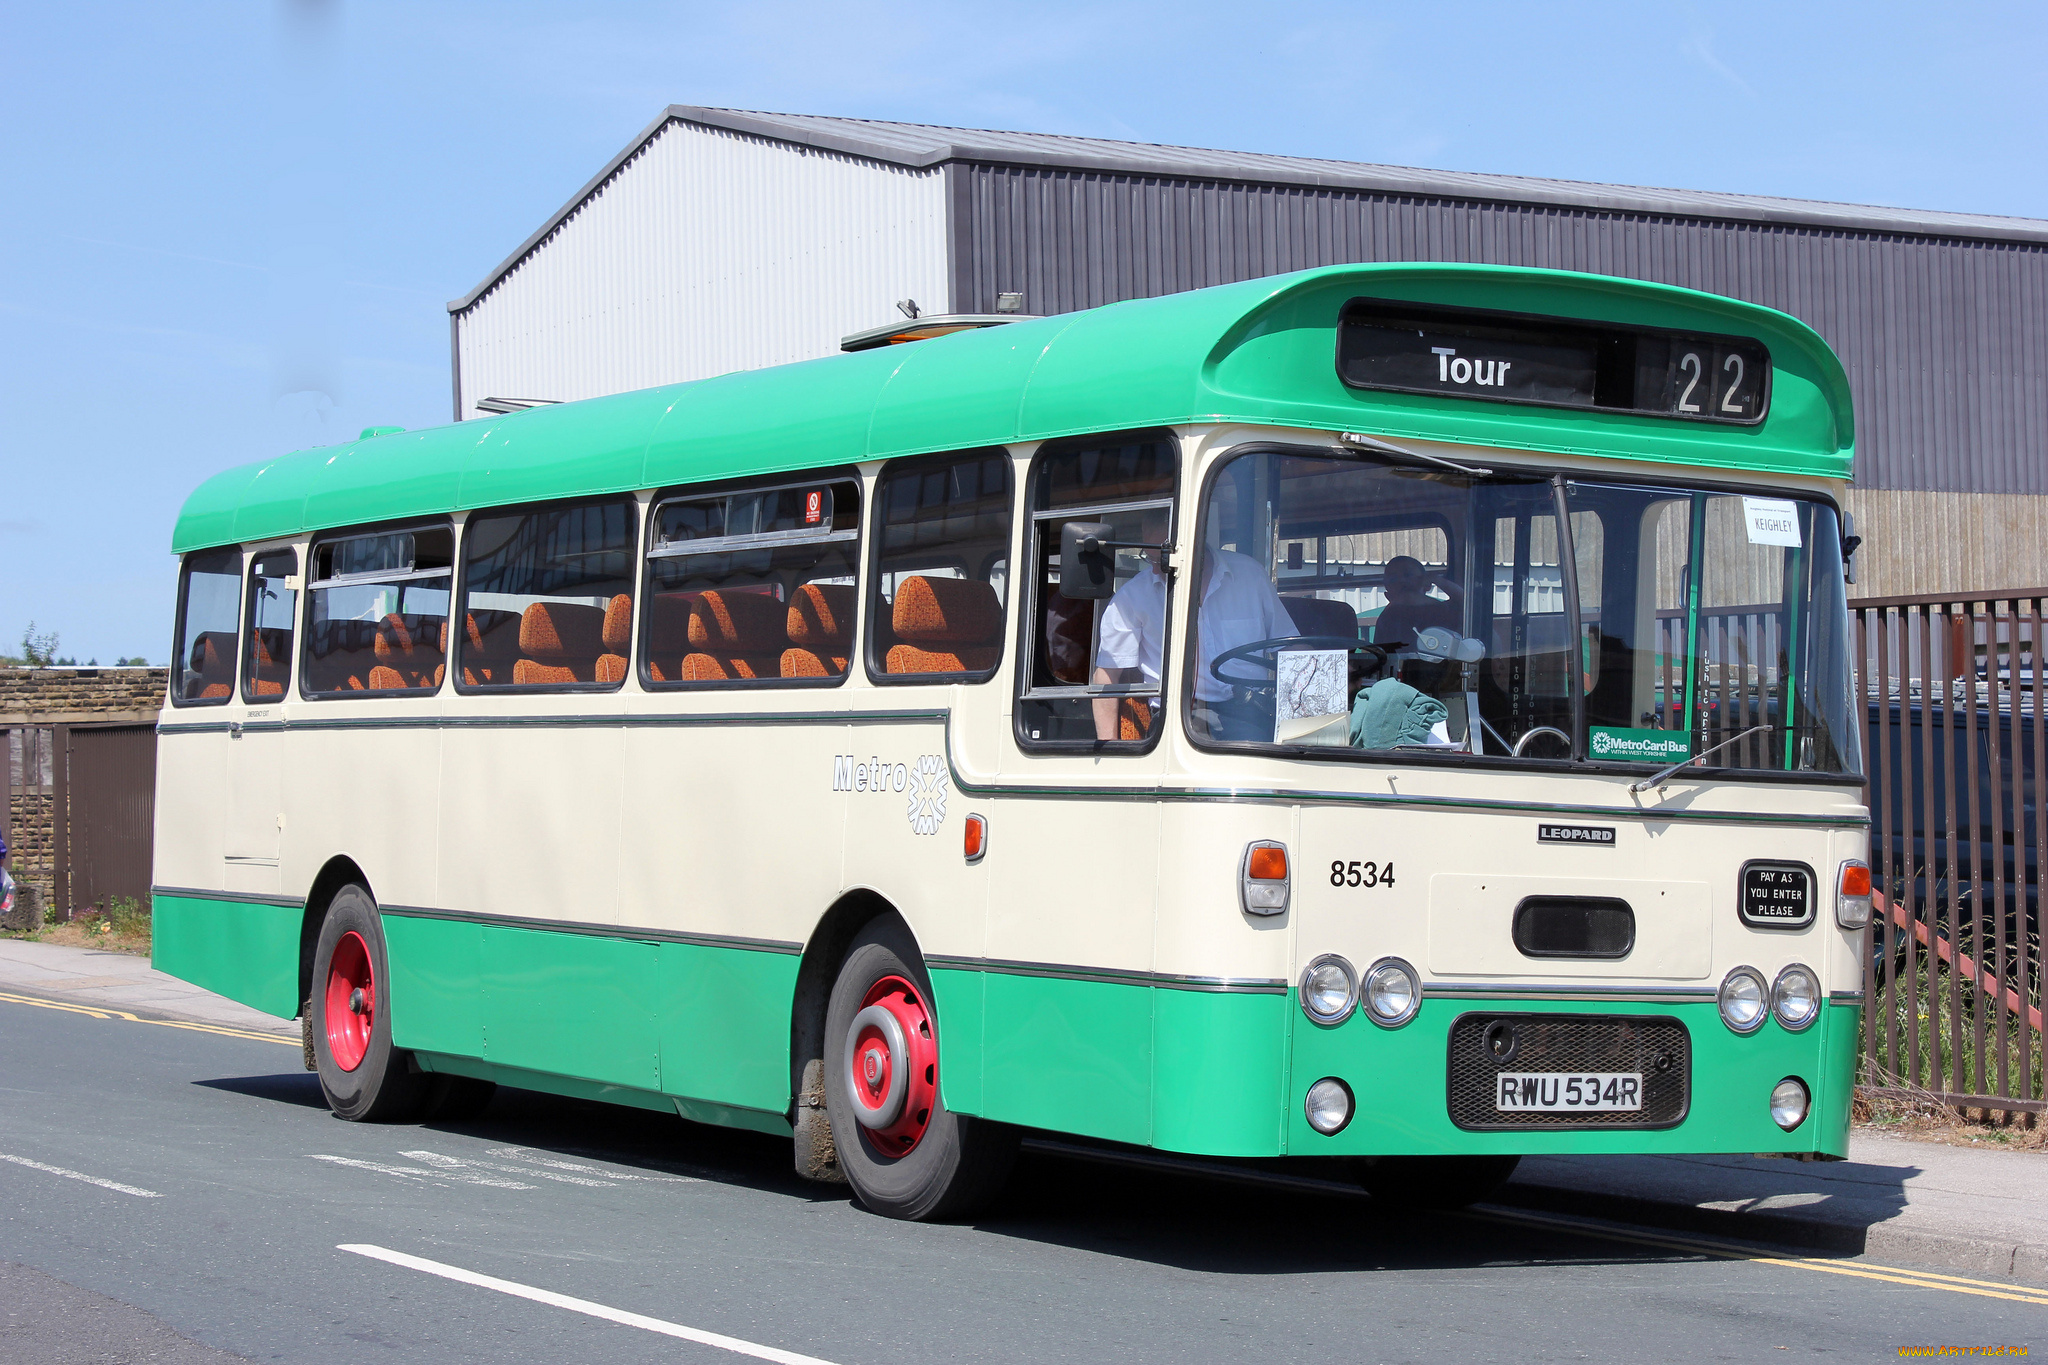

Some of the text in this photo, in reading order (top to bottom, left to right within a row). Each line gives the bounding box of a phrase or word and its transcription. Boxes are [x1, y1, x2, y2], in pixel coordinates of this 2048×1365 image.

[1431, 346, 1511, 386] Tour
[1679, 353, 1744, 412] 22
[1754, 518, 1792, 532] KEIGHLEY
[1668, 741, 1688, 752] Bus
[833, 754, 908, 792] Metro
[1541, 827, 1613, 841] LEOPARD
[1330, 860, 1396, 888] 8534
[1760, 872, 1793, 883] PAY AS
[1750, 887, 1802, 900] YOU ENTER
[1758, 905, 1793, 916] PLEASE
